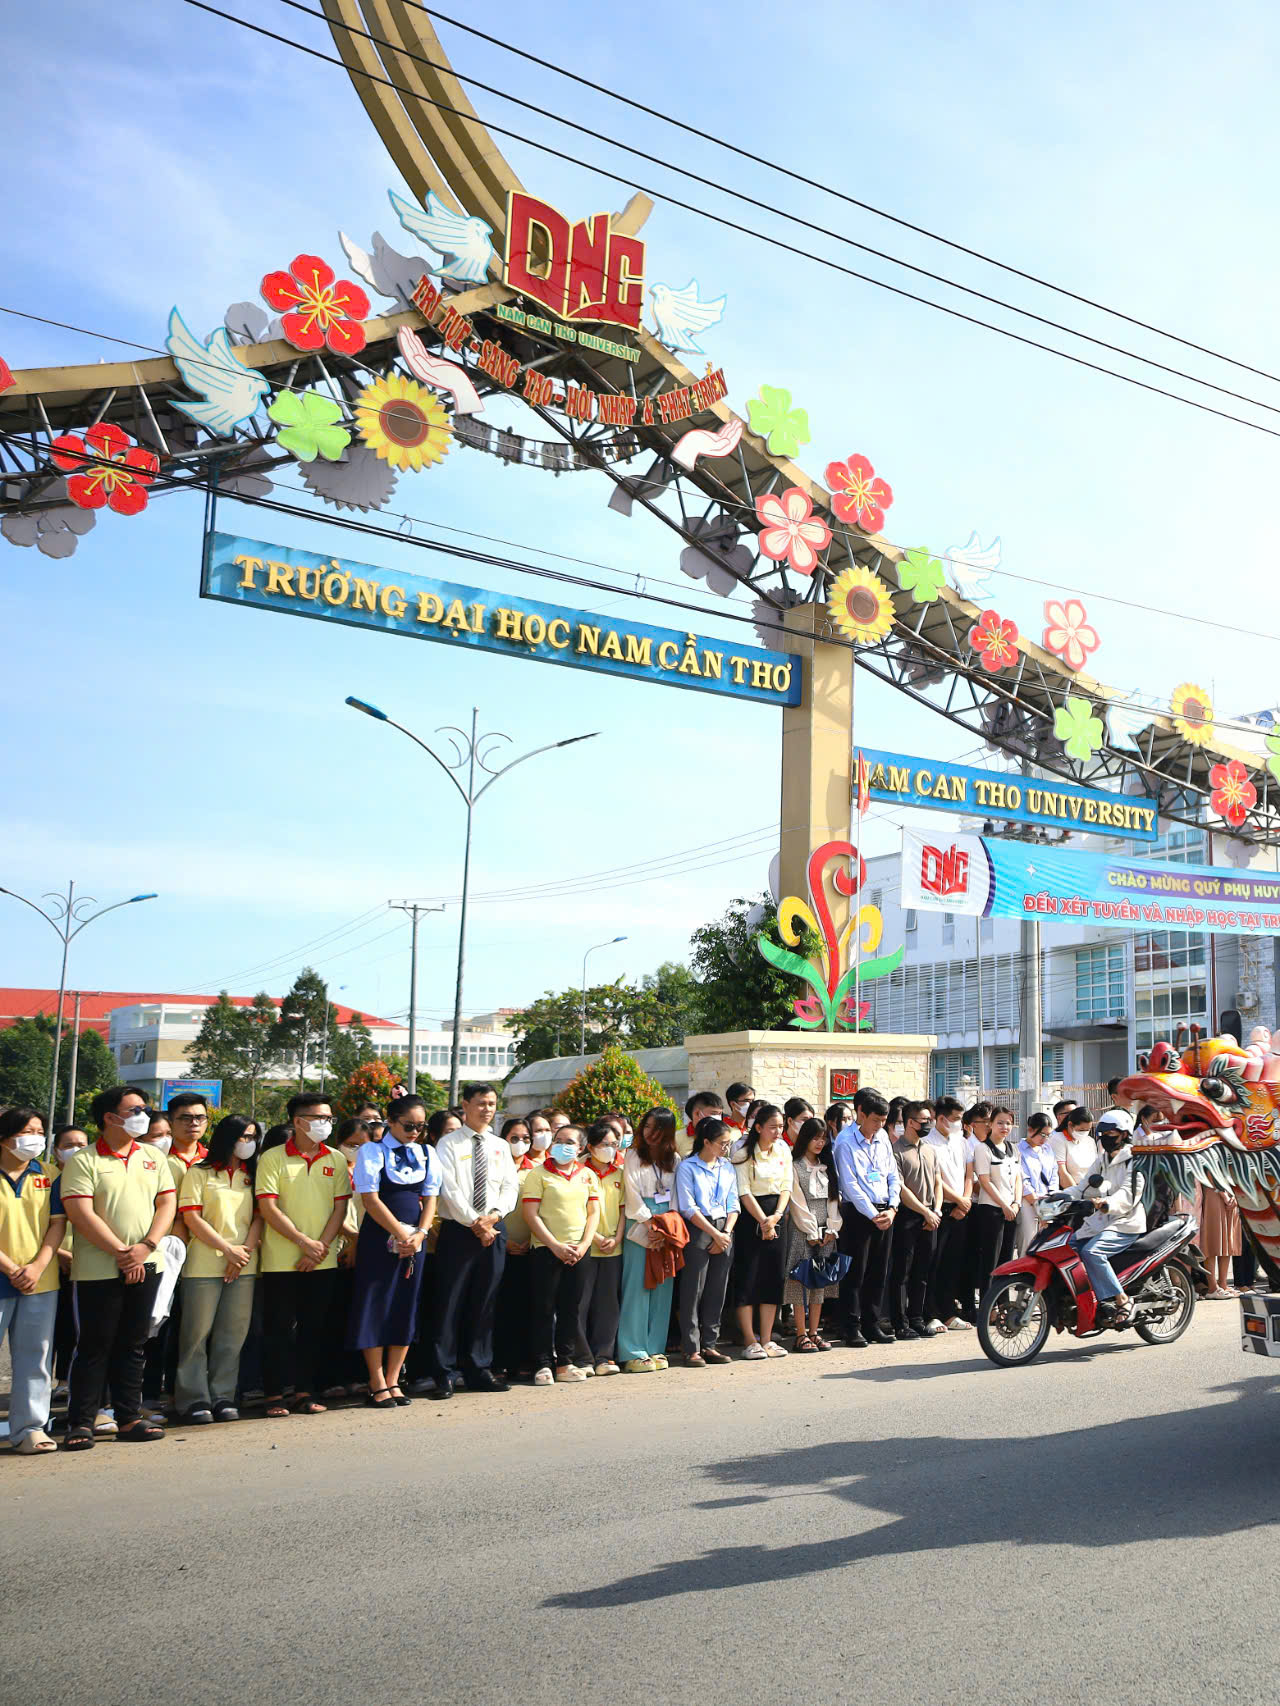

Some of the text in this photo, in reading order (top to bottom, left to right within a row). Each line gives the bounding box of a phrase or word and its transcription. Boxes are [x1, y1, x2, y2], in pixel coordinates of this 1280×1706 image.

[504, 189, 646, 334] DNC
[411, 274, 448, 320] TRÍ
[477, 339, 521, 388] SÁNG
[523, 368, 553, 407] TẠO
[566, 382, 595, 424] HỘI
[497, 304, 641, 362] NAM CAN THO UNIVERSITY
[233, 554, 792, 692] TRƯỜNG ĐẠI HỌC NAM CẦN THƠ
[915, 770, 967, 801] CAN
[974, 780, 1022, 809] THO
[1026, 788, 1155, 831] UNIVERSITY
[921, 844, 968, 896] DNC
[1107, 870, 1148, 888] CHÀO
[1150, 873, 1192, 893] MỪNG
[1193, 879, 1221, 896] QUÝ
[1224, 881, 1250, 900] PHỤ
[1023, 891, 1057, 913] ĐẾN
[1060, 895, 1090, 916] XÉT
[1141, 901, 1164, 922] VÀ
[1165, 905, 1205, 928] NHẬP
[1206, 909, 1236, 928] HỌC
[1238, 911, 1261, 931] TẠI
